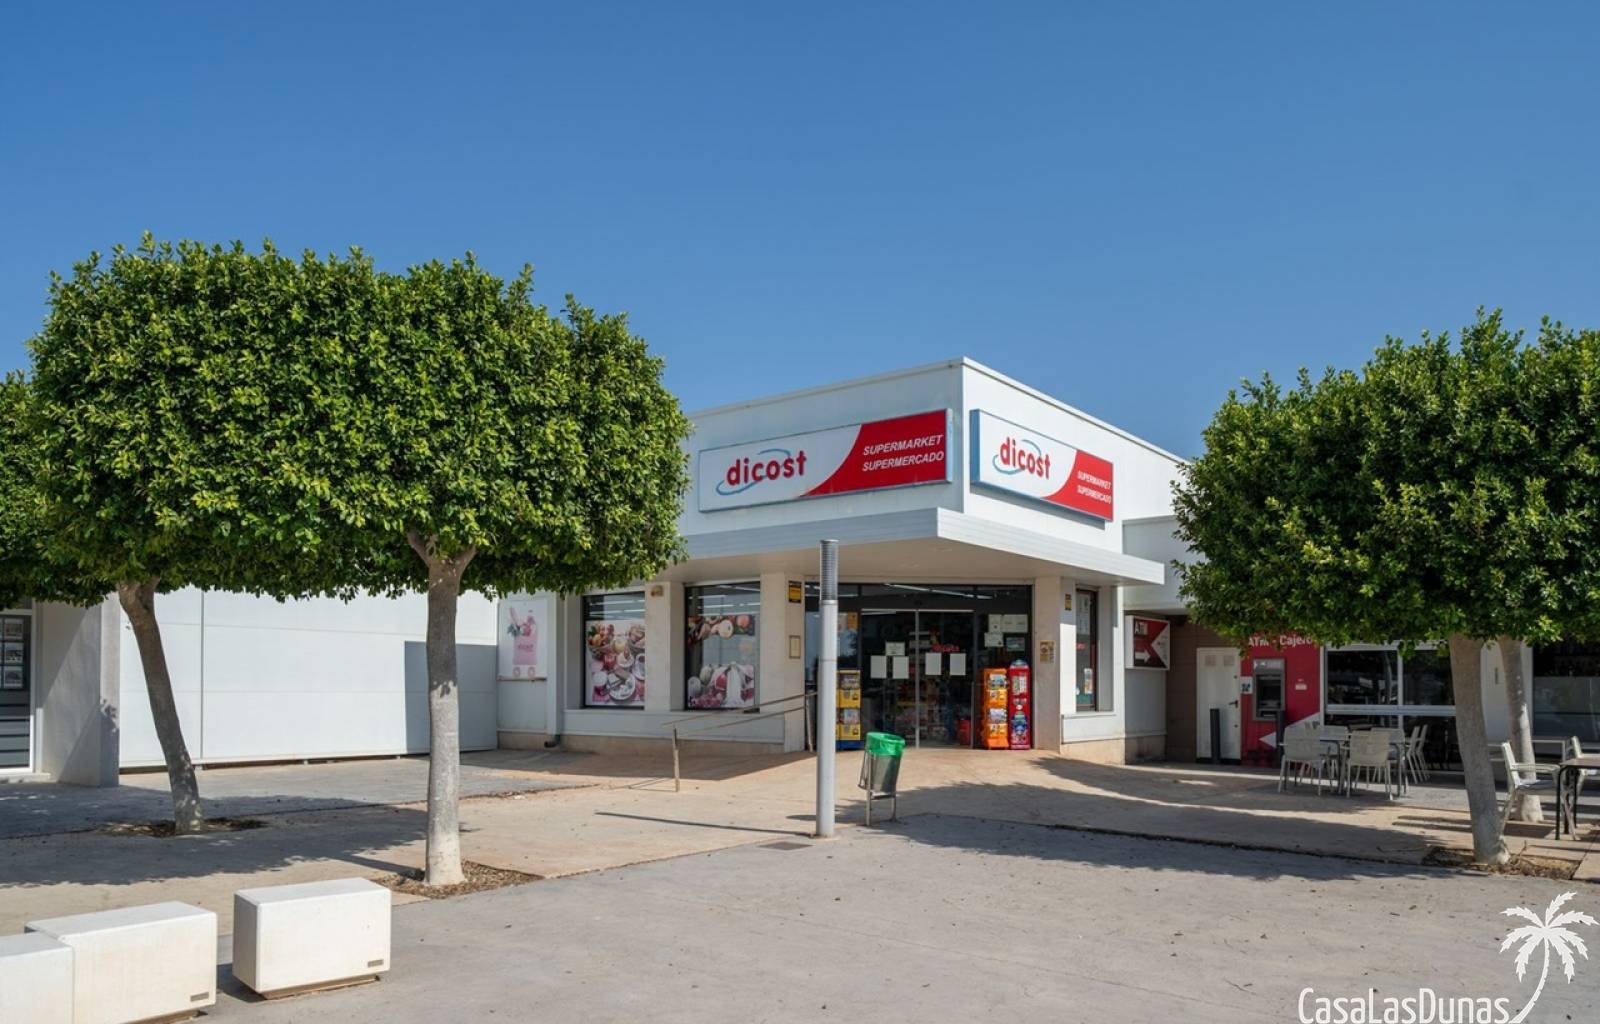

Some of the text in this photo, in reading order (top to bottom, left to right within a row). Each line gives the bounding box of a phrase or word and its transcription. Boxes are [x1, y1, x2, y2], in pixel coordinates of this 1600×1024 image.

[863, 434, 943, 456] SUPERMARKET
[727, 450, 807, 486] dicost
[862, 451, 945, 472] SUPERMERCADO
[1000, 436, 1050, 480] dicost
[1077, 470, 1111, 489] SUPERMARKET
